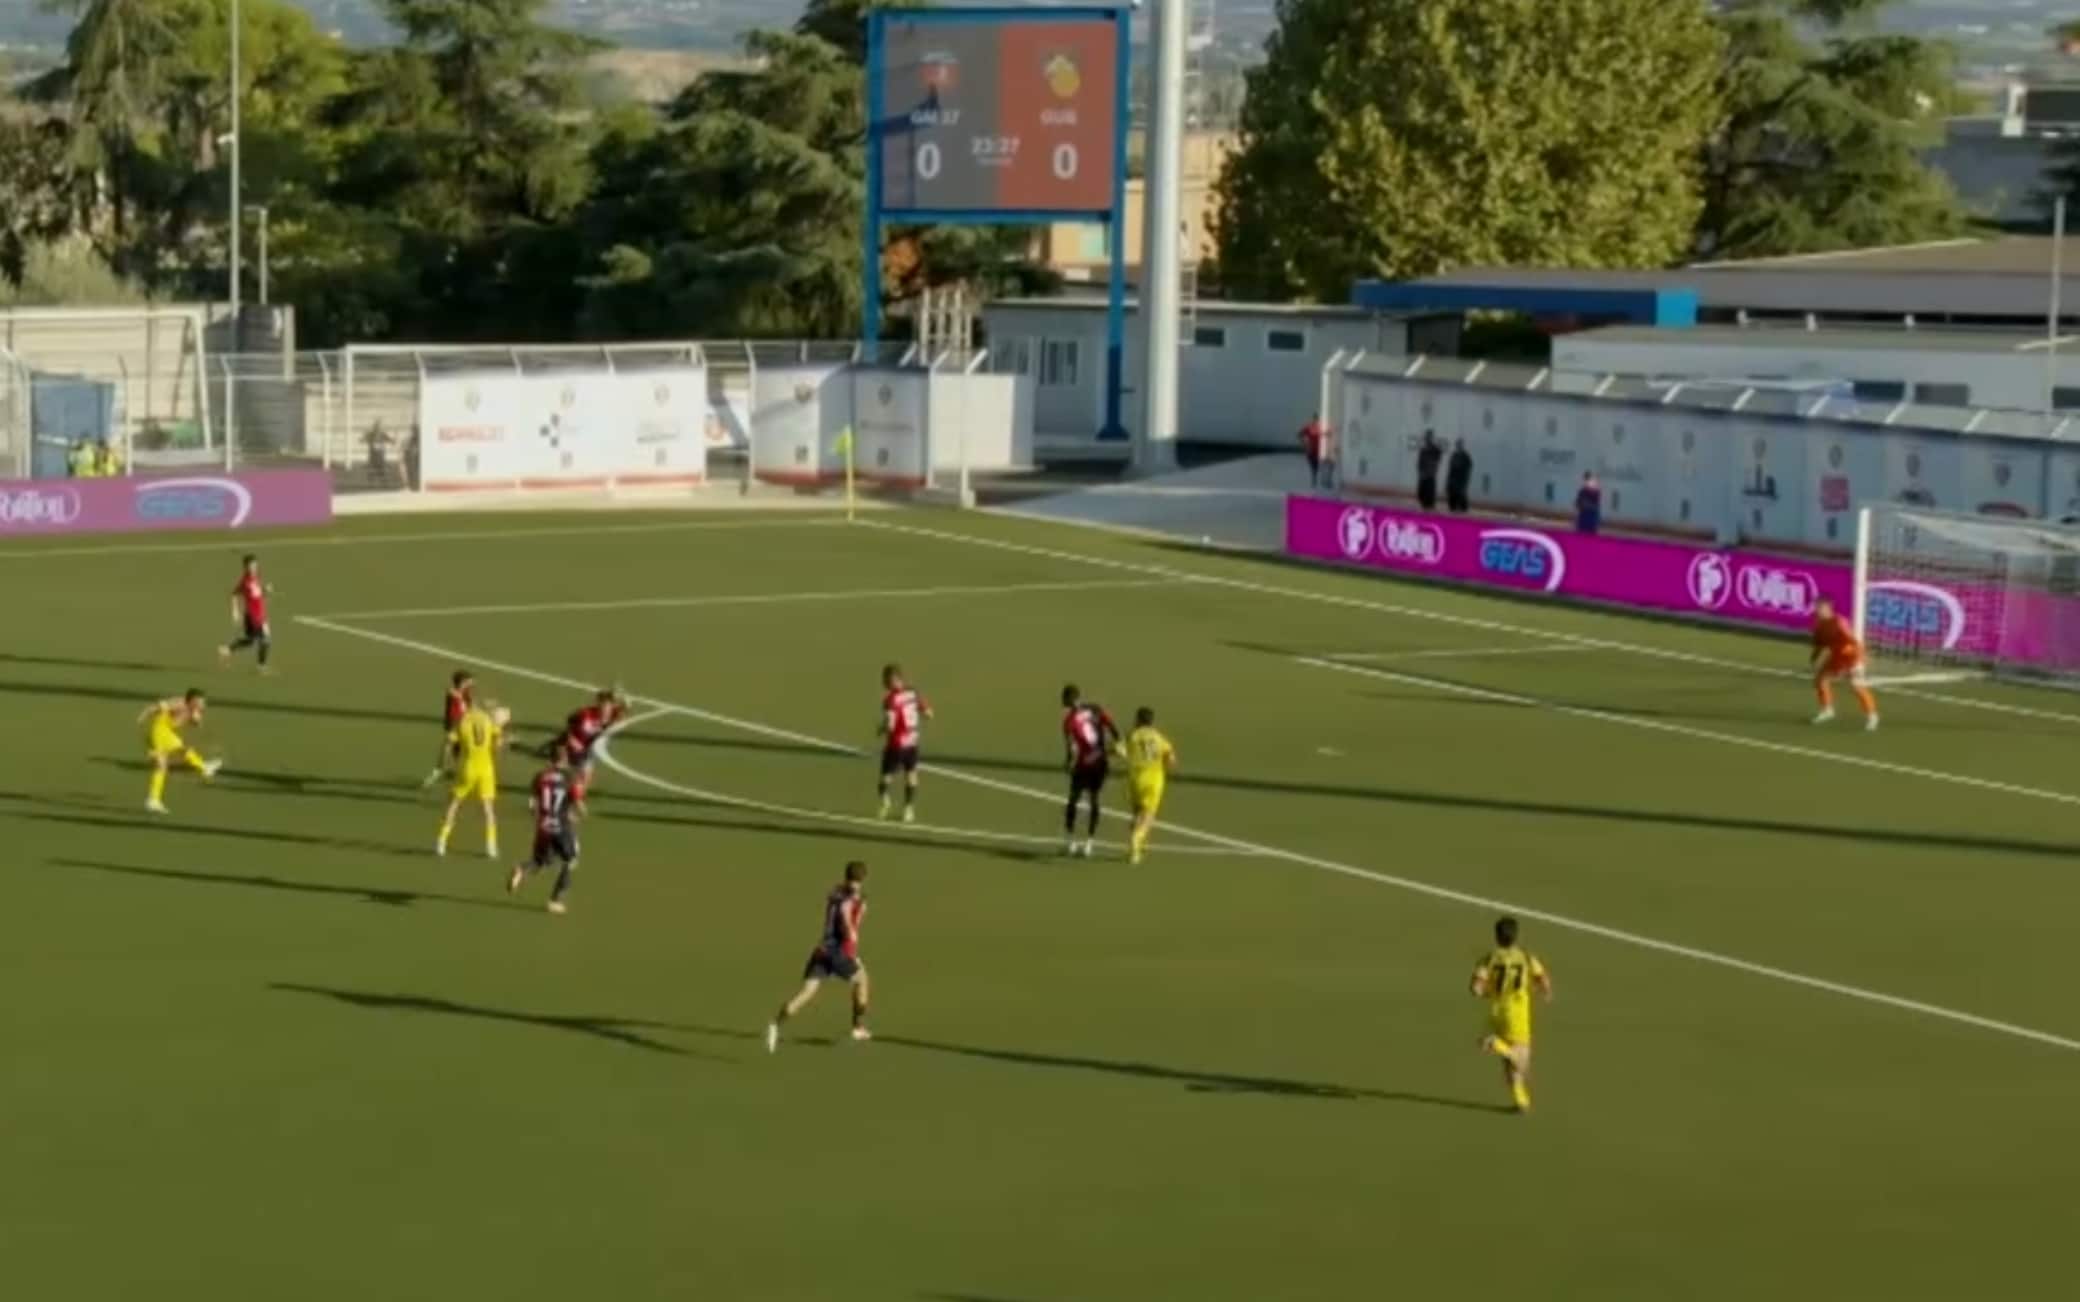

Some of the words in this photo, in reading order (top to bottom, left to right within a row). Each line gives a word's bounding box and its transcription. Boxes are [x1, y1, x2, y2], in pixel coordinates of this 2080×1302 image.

[917, 142, 941, 180] 0
[1053, 143, 1078, 180] 0
[542, 786, 567, 812] 17
[1492, 962, 1524, 993] 77
